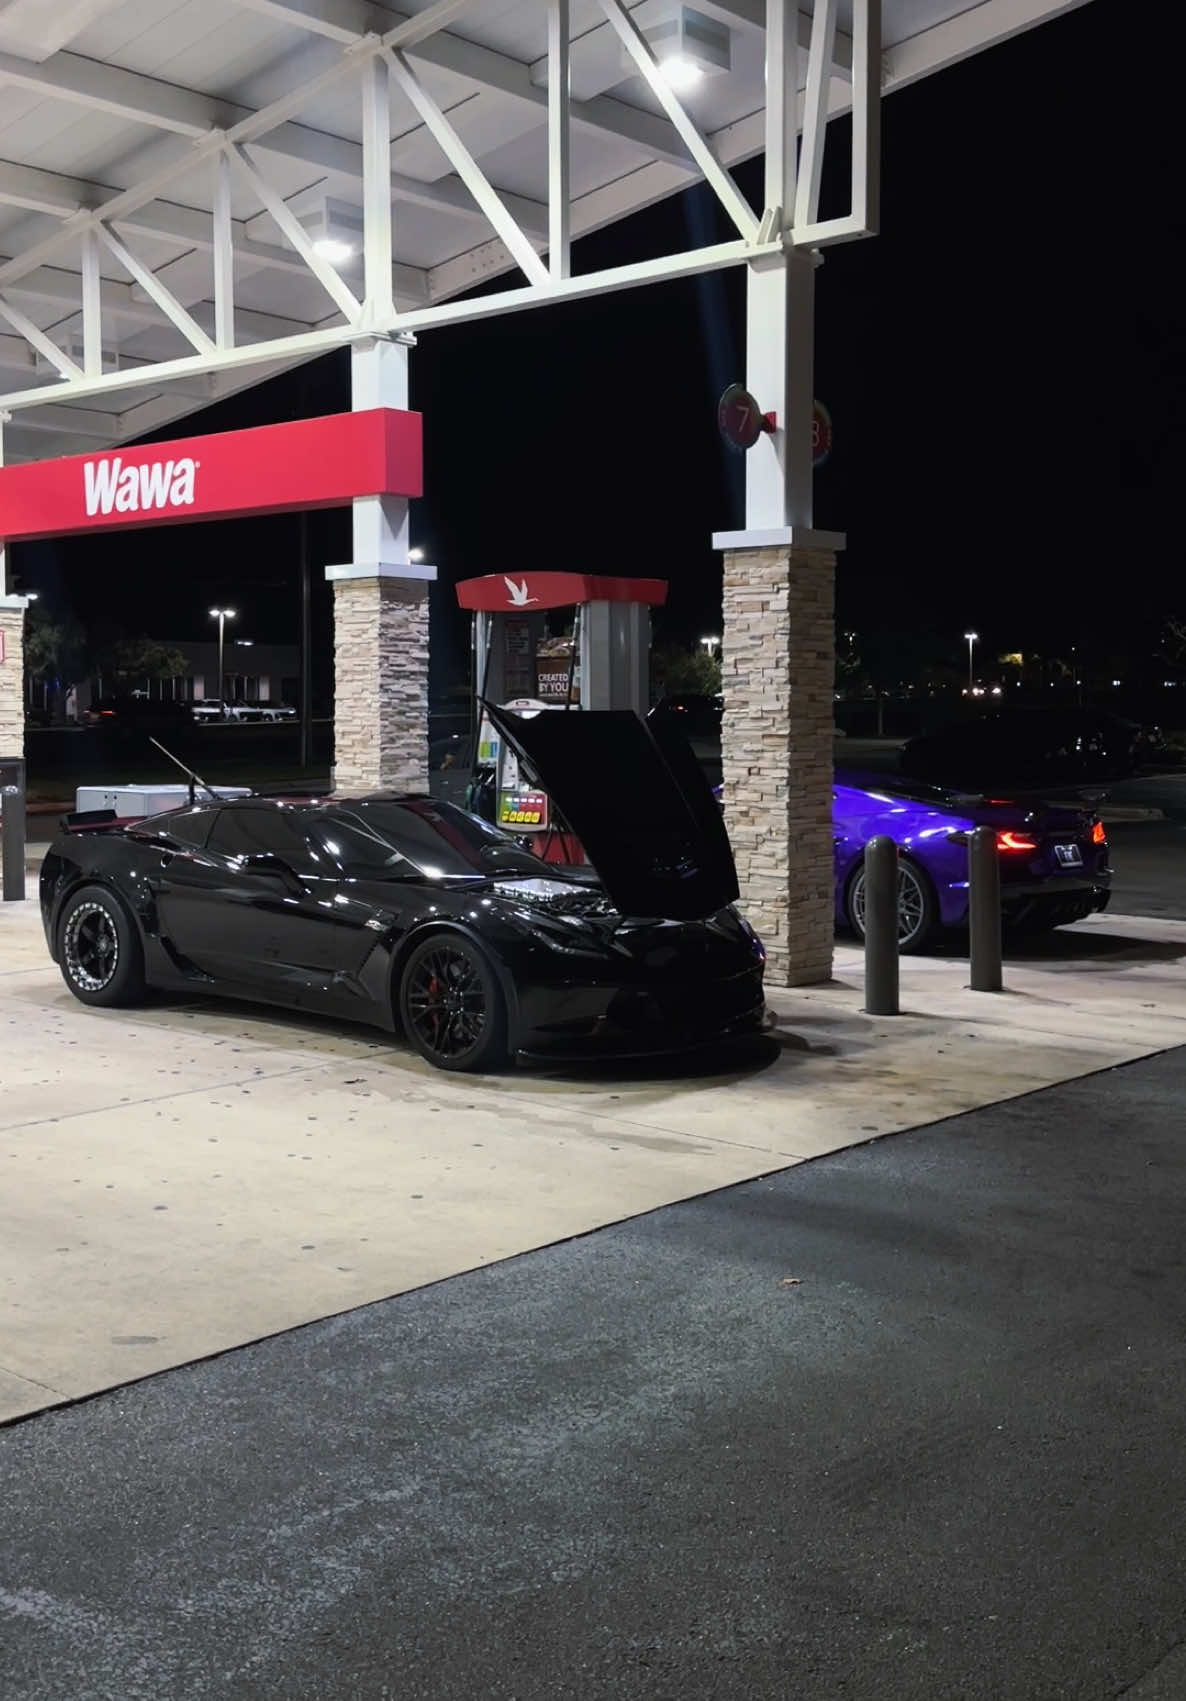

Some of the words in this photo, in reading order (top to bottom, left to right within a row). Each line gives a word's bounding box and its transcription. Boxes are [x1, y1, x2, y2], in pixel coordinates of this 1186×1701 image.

[735, 405, 750, 433] 7
[83, 457, 196, 517] Wawa
[538, 673, 569, 682] CREATED
[539, 682, 548, 692] BY
[550, 682, 569, 692] YOU
